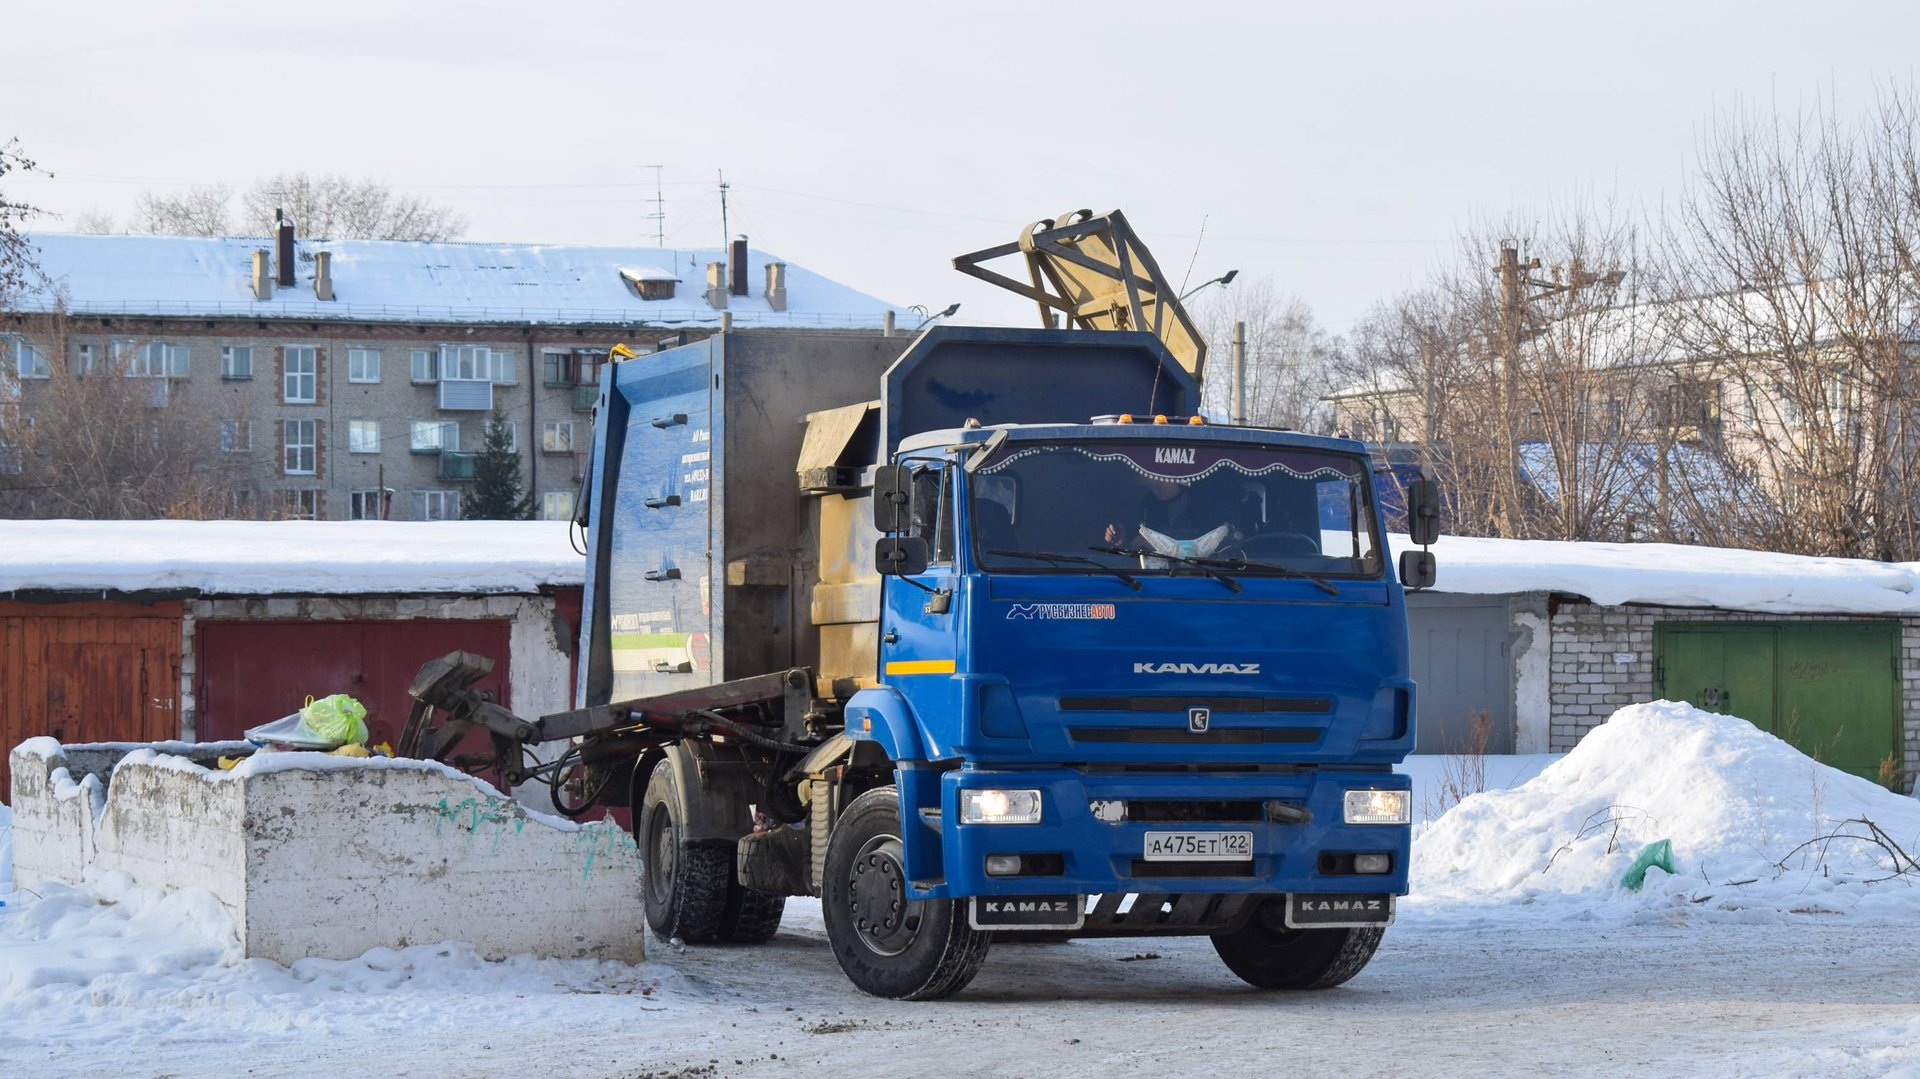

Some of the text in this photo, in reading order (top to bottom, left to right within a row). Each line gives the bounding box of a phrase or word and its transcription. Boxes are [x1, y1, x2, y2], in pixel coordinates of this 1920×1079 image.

[1155, 447, 1196, 464] KAMAZ
[1039, 604, 1115, 619] РУСБИЗНЕСАВТО
[1133, 663, 1260, 674] KAMAZ
[1222, 835, 1246, 848] 122
[986, 902, 1068, 912] KAMAZ
[1302, 900, 1381, 911] KAMAZ
